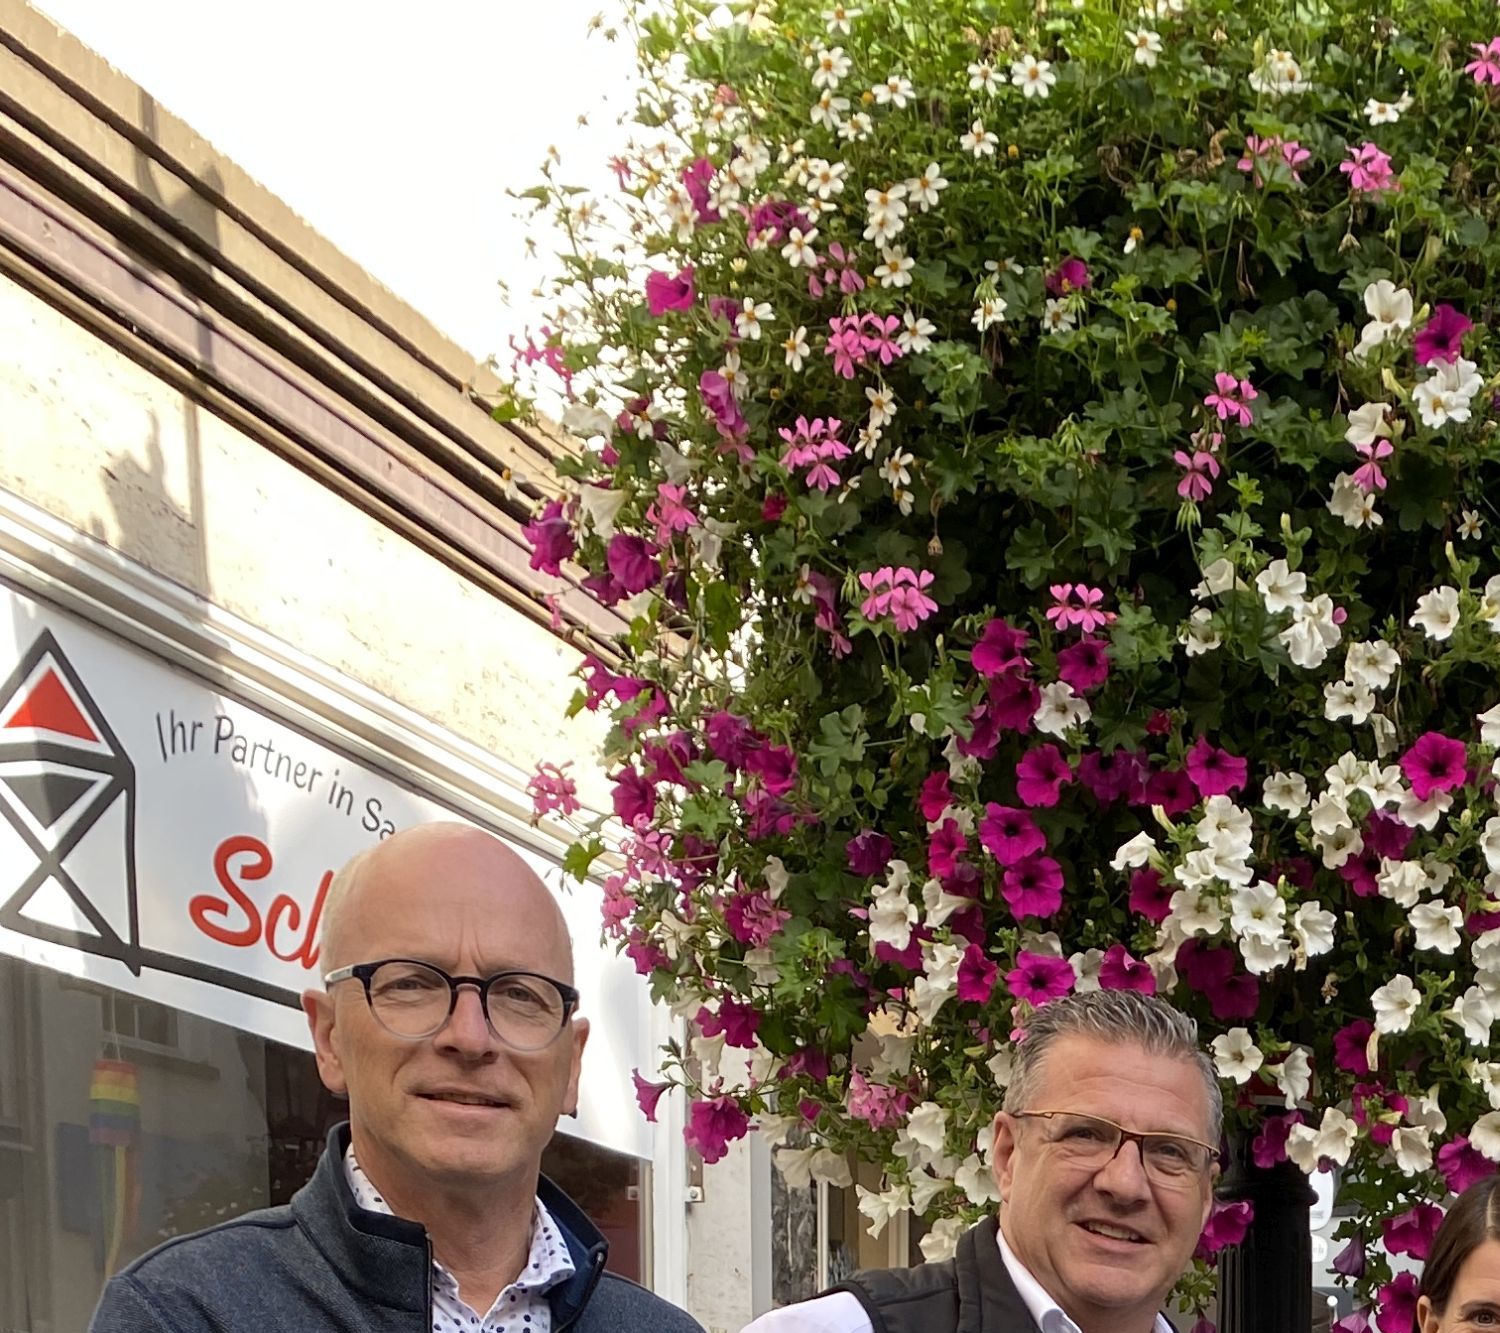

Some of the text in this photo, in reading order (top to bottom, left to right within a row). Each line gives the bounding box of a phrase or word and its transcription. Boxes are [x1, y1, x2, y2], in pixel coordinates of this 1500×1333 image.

[157, 709, 203, 763] Ihr
[214, 715, 323, 792] Partner
[328, 769, 354, 816] in
